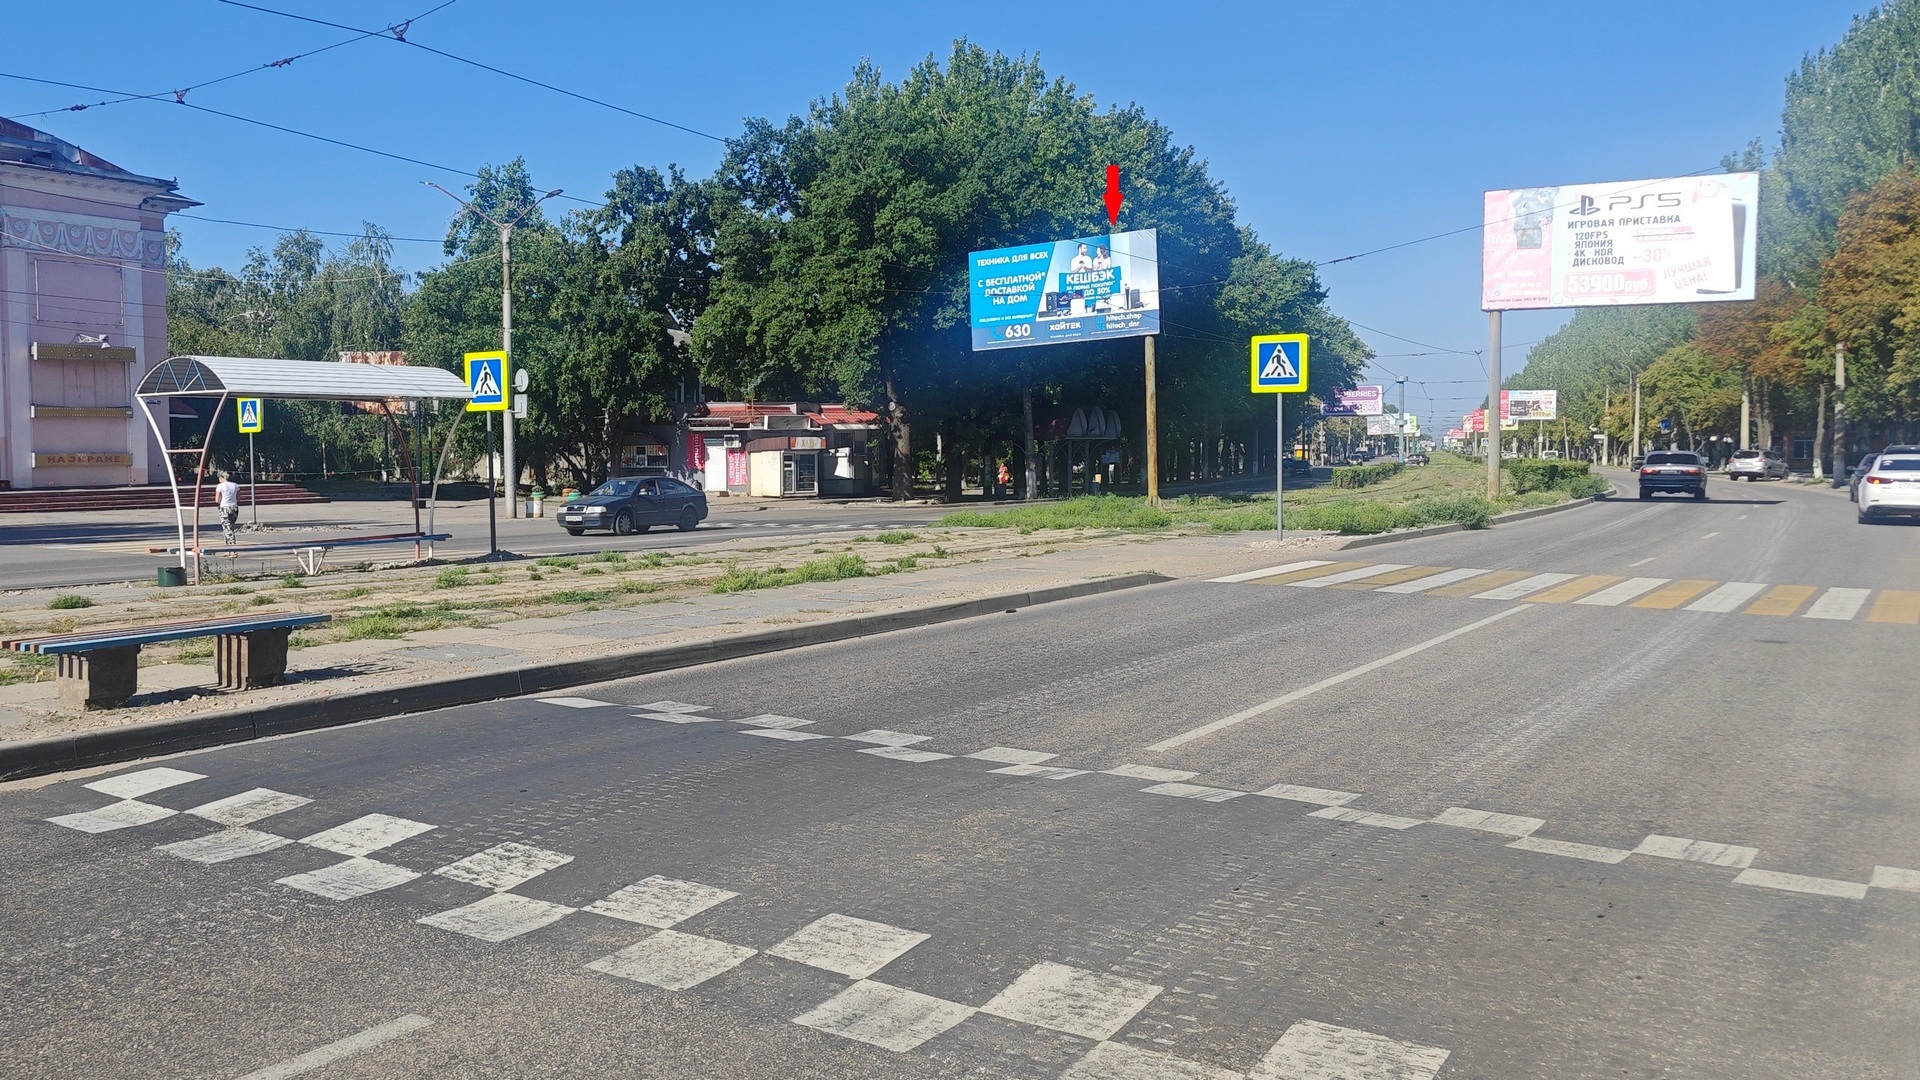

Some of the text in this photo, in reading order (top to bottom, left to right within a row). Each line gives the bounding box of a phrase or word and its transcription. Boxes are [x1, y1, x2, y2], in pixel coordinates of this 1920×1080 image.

[1608, 191, 1682, 211] PS5
[1567, 214, 1681, 230] ИГРОВАЯ ПРИСТАВКА
[1574, 230, 1609, 241] 120FPS
[1574, 239, 1613, 249] ЯПОНИЯ
[977, 251, 1049, 267] ТЕХНИКА ДЛЯ ВСЕХ
[1574, 248, 1614, 257] 4K HDR
[1572, 255, 1625, 268] ДИСКОВОД
[1664, 256, 1712, 280] ЛУЧШАЯ
[977, 279, 984, 288] С
[1066, 269, 1115, 285] КЕШБЭК
[1674, 272, 1709, 290] ЦЕНА!
[984, 282, 1036, 298] ДОСТАВКОЙ
[1083, 286, 1111, 298] ДО 50%
[992, 294, 1028, 306] НА ДОМ
[1105, 313, 1143, 322] hitech.shop
[1005, 324, 1031, 338] 630
[47, 455, 121, 464] НА ЭКРАНЕ
